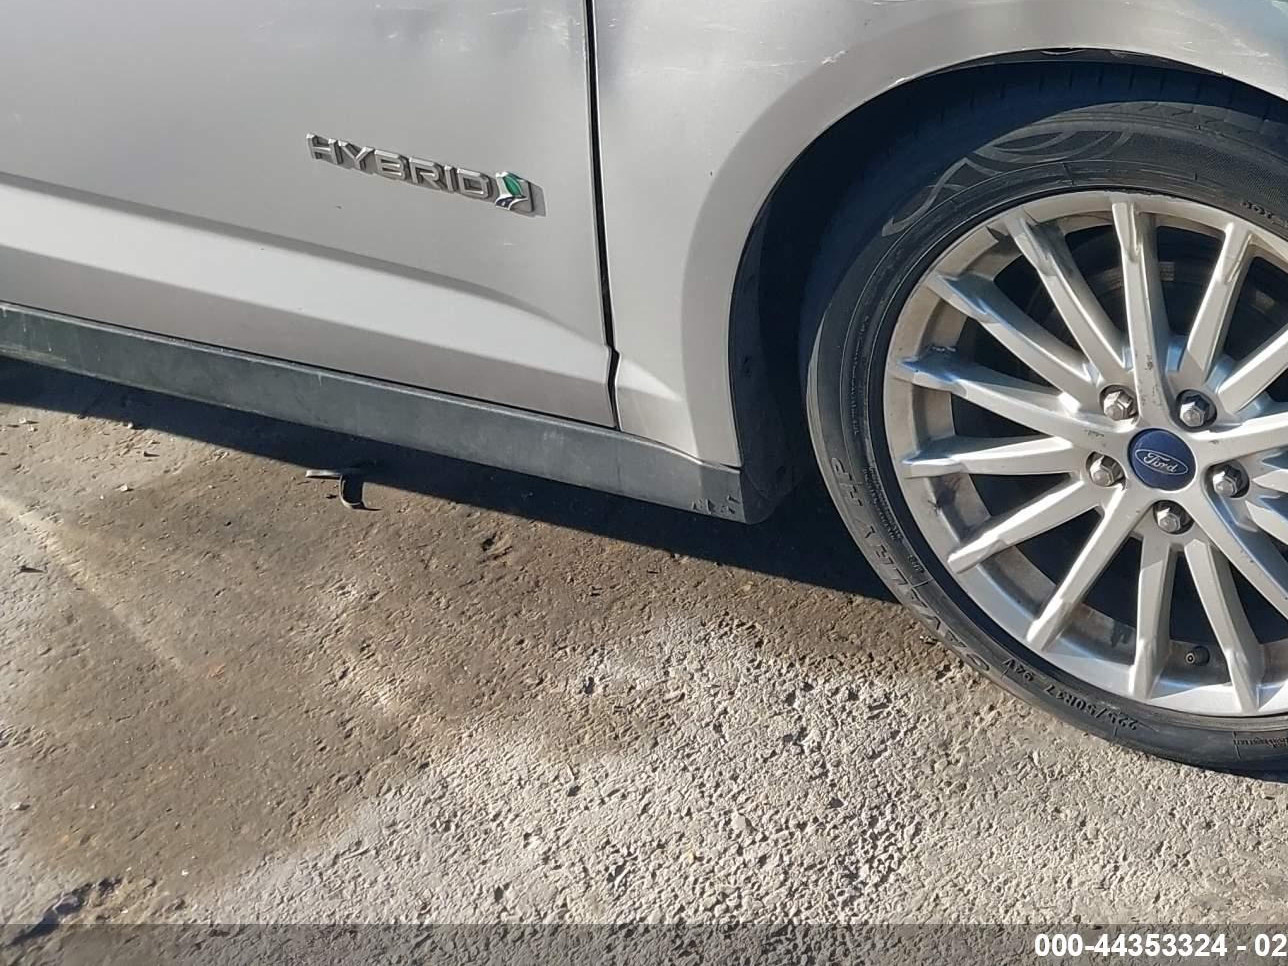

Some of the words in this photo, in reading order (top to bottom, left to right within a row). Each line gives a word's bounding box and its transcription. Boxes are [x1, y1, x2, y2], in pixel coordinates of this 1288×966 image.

[305, 132, 493, 202] HYBRID
[1143, 451, 1178, 473] Ford
[1042, 684, 1139, 732] 225/50R17
